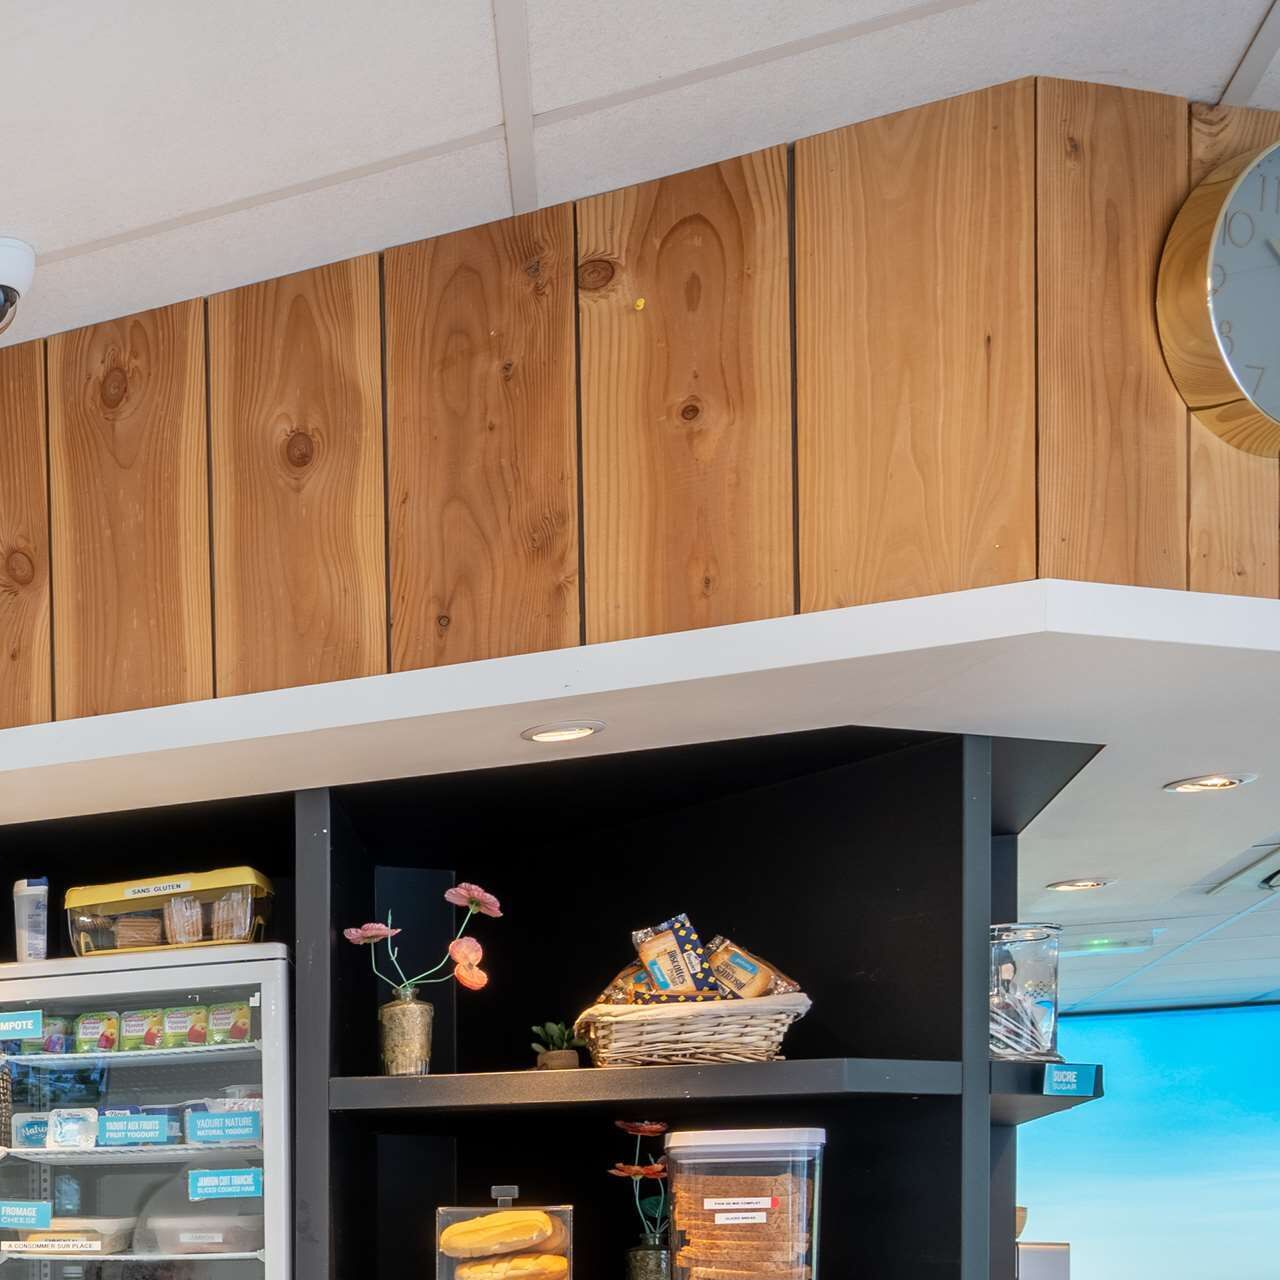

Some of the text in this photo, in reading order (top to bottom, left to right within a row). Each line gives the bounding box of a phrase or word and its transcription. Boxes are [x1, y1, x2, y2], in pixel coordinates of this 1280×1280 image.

[1222, 210, 1256, 249] 10
[1244, 364, 1266, 398] 7
[132, 883, 182, 895] SANS GLUTEN
[196, 1116, 253, 1129] YAOURT NATURE
[1, 1206, 37, 1216] FROMAGE
[1, 1216, 37, 1224] CHEESE
[71, 1242, 93, 1250] PLACE
